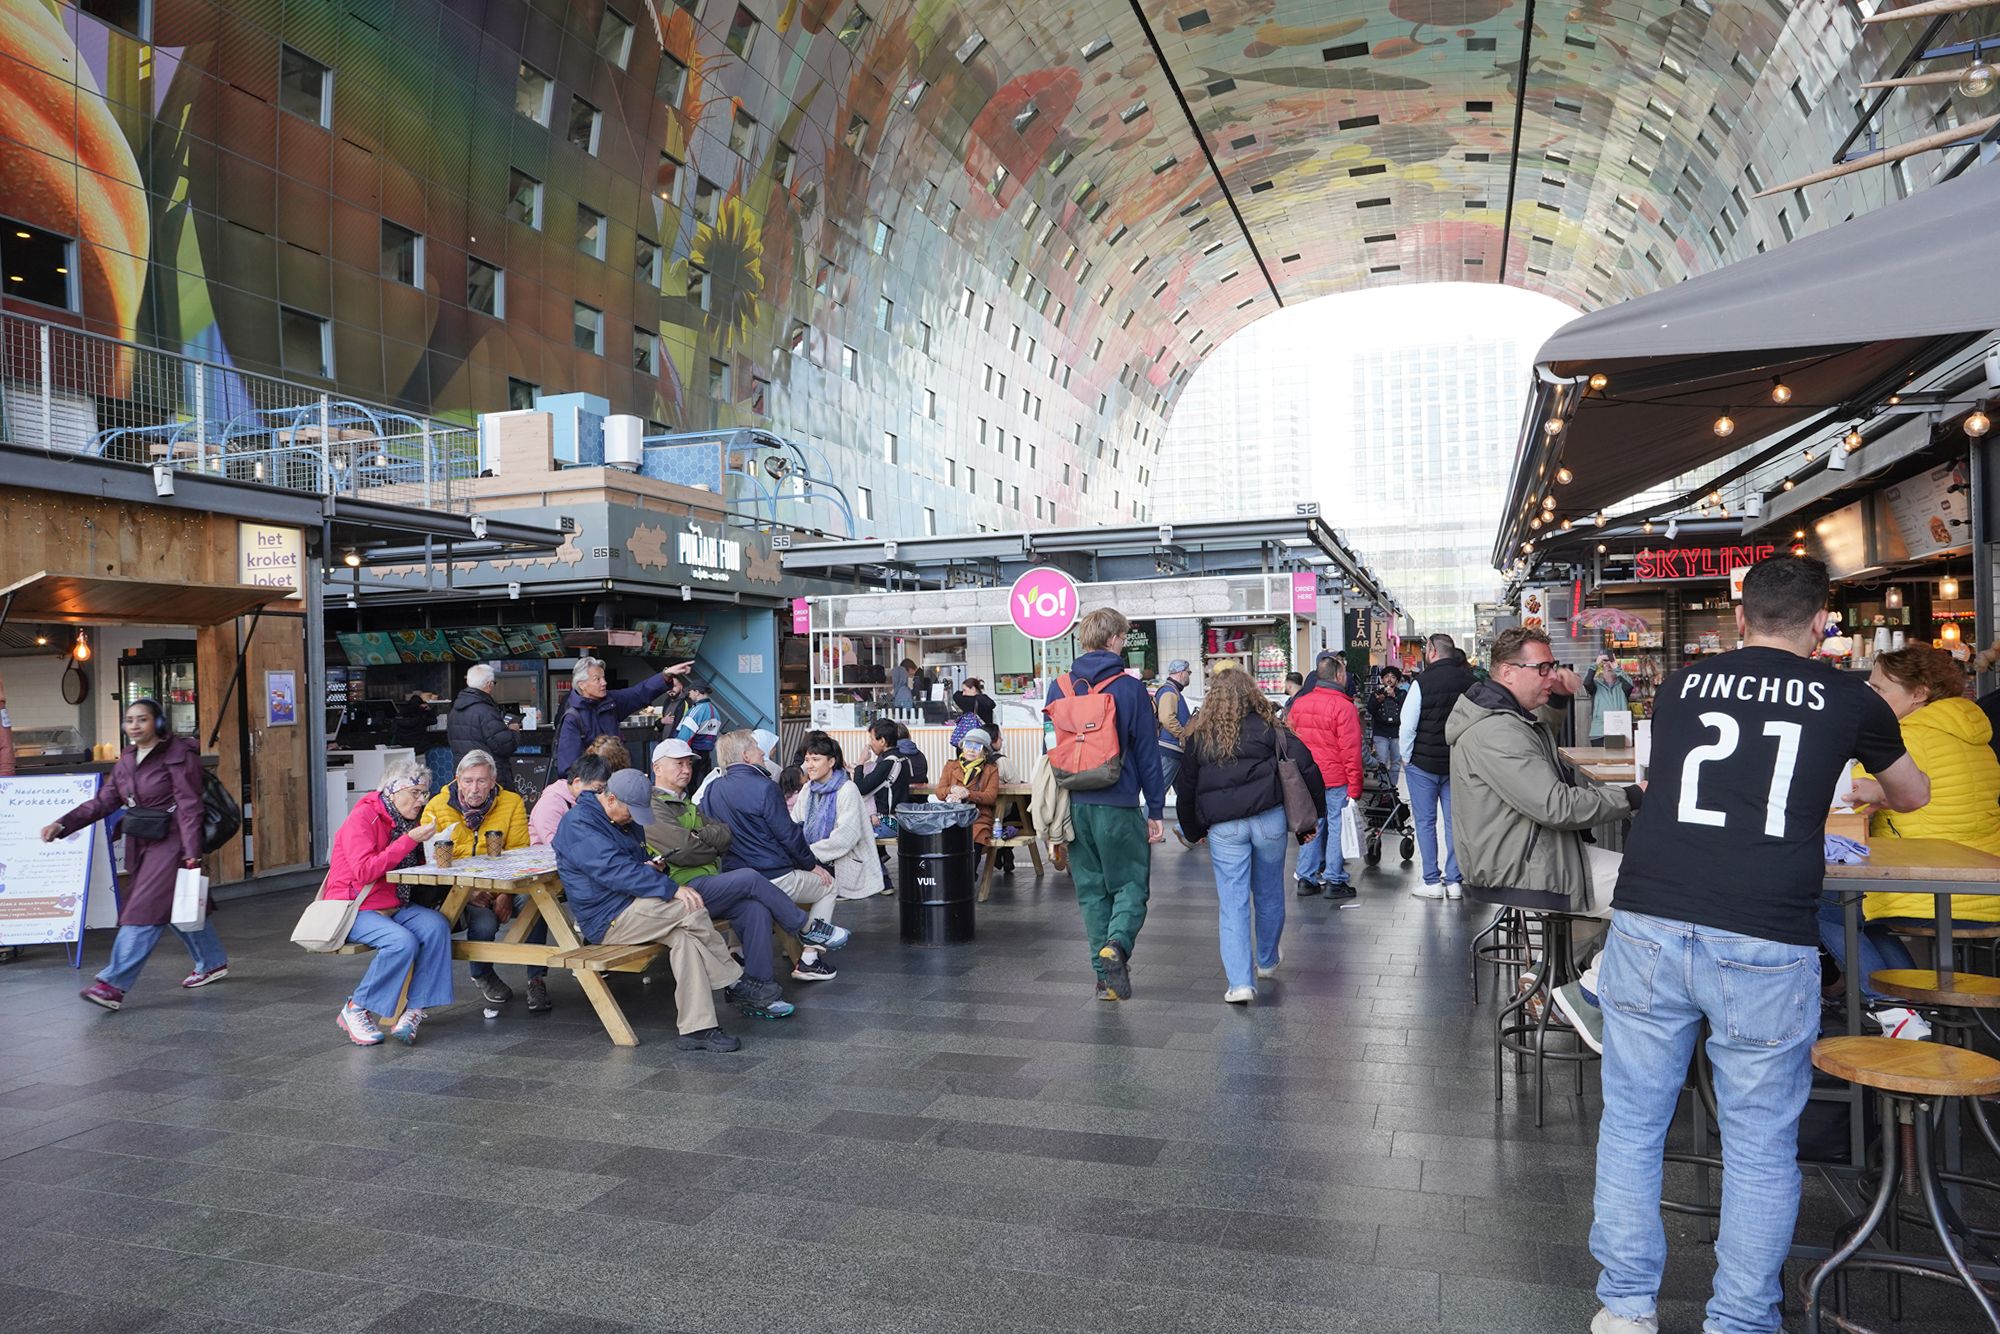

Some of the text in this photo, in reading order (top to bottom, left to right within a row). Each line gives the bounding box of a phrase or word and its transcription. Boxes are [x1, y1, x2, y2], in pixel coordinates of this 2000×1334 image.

[1297, 503, 1317, 515] 52
[561, 517, 575, 529] 89
[258, 531, 282, 546] het
[773, 536, 789, 547] 56
[247, 551, 296, 567] kroket
[593, 547, 608, 558] 86
[719, 539, 740, 572] FOOD
[254, 573, 292, 587] loket
[1017, 586, 1067, 618] YO!
[1356, 608, 1366, 638] TEA
[1680, 673, 1825, 711] PINCHOS
[1678, 711, 1803, 838] 21
[9, 798, 76, 806] Kroketten
[917, 877, 937, 886] VUIL
